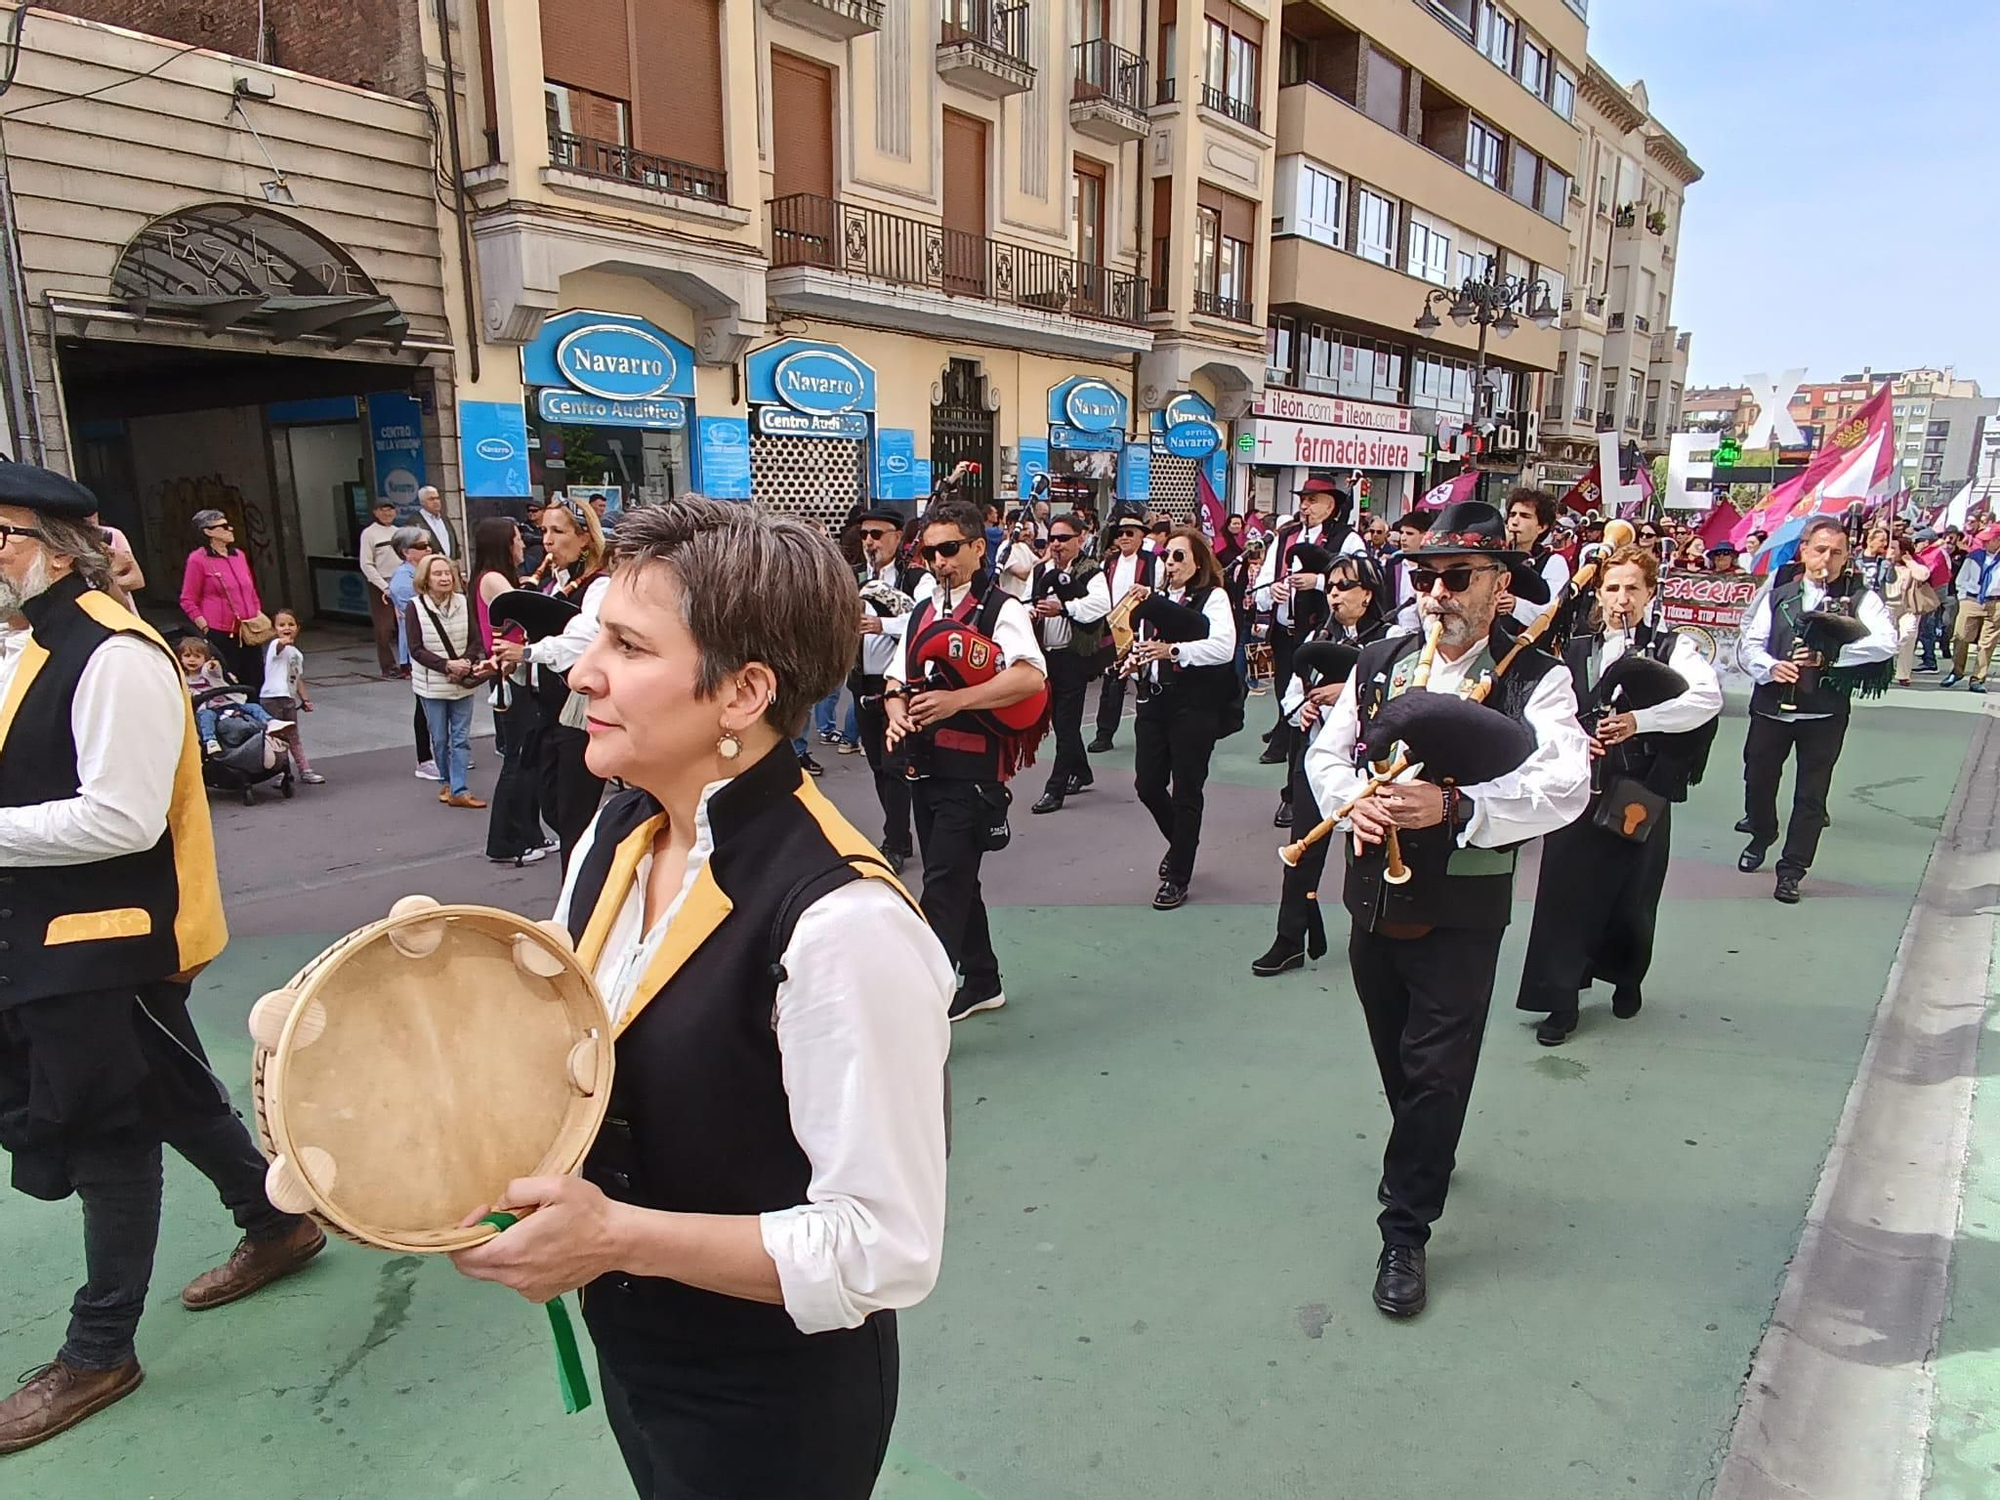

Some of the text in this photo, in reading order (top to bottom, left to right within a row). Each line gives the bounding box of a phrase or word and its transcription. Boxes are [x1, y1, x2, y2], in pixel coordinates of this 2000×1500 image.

[144, 222, 295, 288] PASAJE
[320, 262, 371, 298] DE
[573, 347, 663, 376] Navarro
[787, 370, 853, 395] Navarro
[548, 398, 680, 420] Centro Auditivo
[765, 412, 809, 428] Centro
[481, 446, 510, 454] Navarro
[1170, 437, 1215, 447] Navarro
[1294, 427, 1409, 467] farmacia sirera
[1663, 577, 1756, 604] SACRIFI
